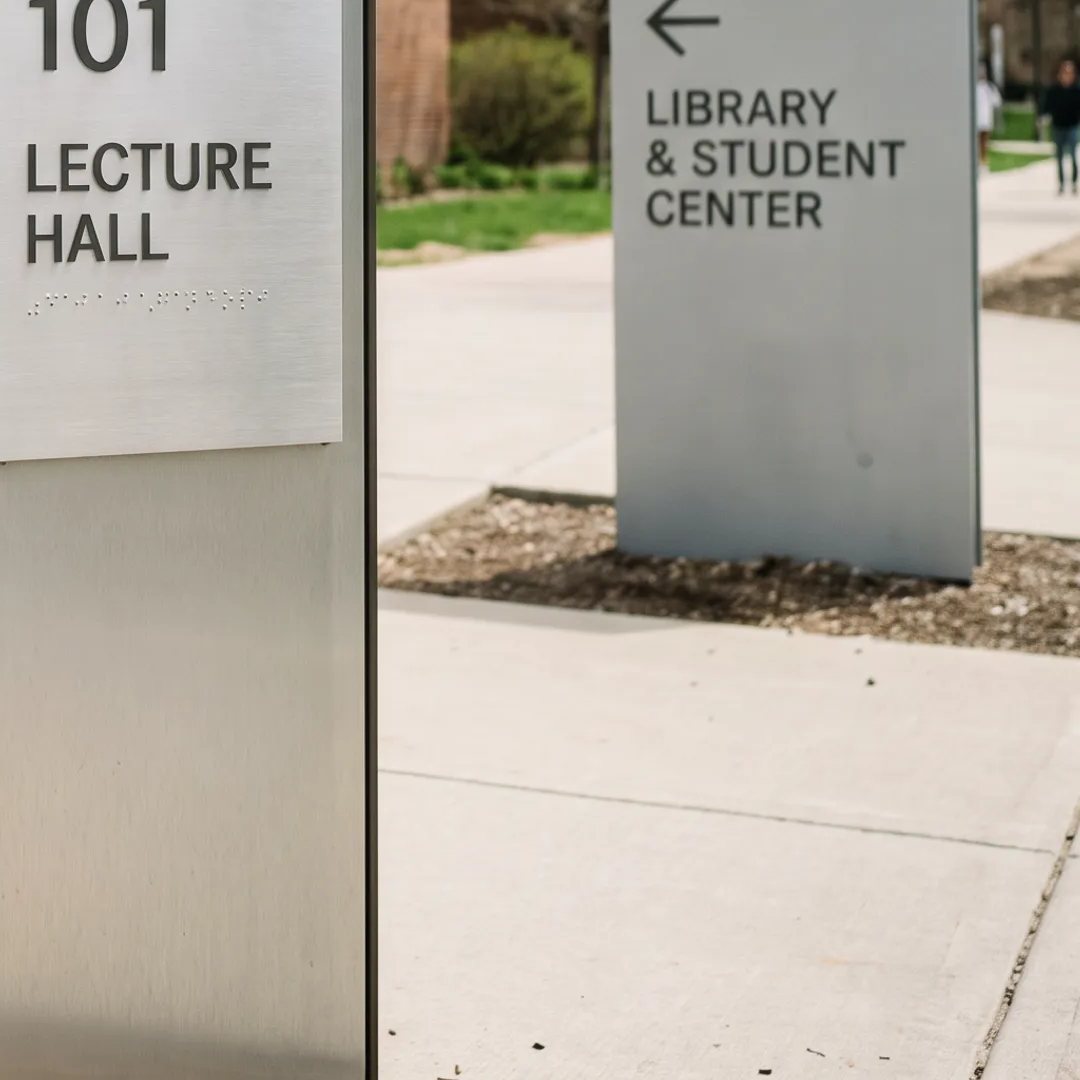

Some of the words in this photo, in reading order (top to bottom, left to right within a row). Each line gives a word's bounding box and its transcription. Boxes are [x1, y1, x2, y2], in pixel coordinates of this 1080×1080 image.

[647, 89, 837, 126] LIBRARY
[27, 142, 273, 193] LECTURE
[646, 139, 676, 177] &
[692, 139, 906, 178] STUDENT
[646, 189, 822, 228] CENTER
[27, 212, 169, 264] HALL
